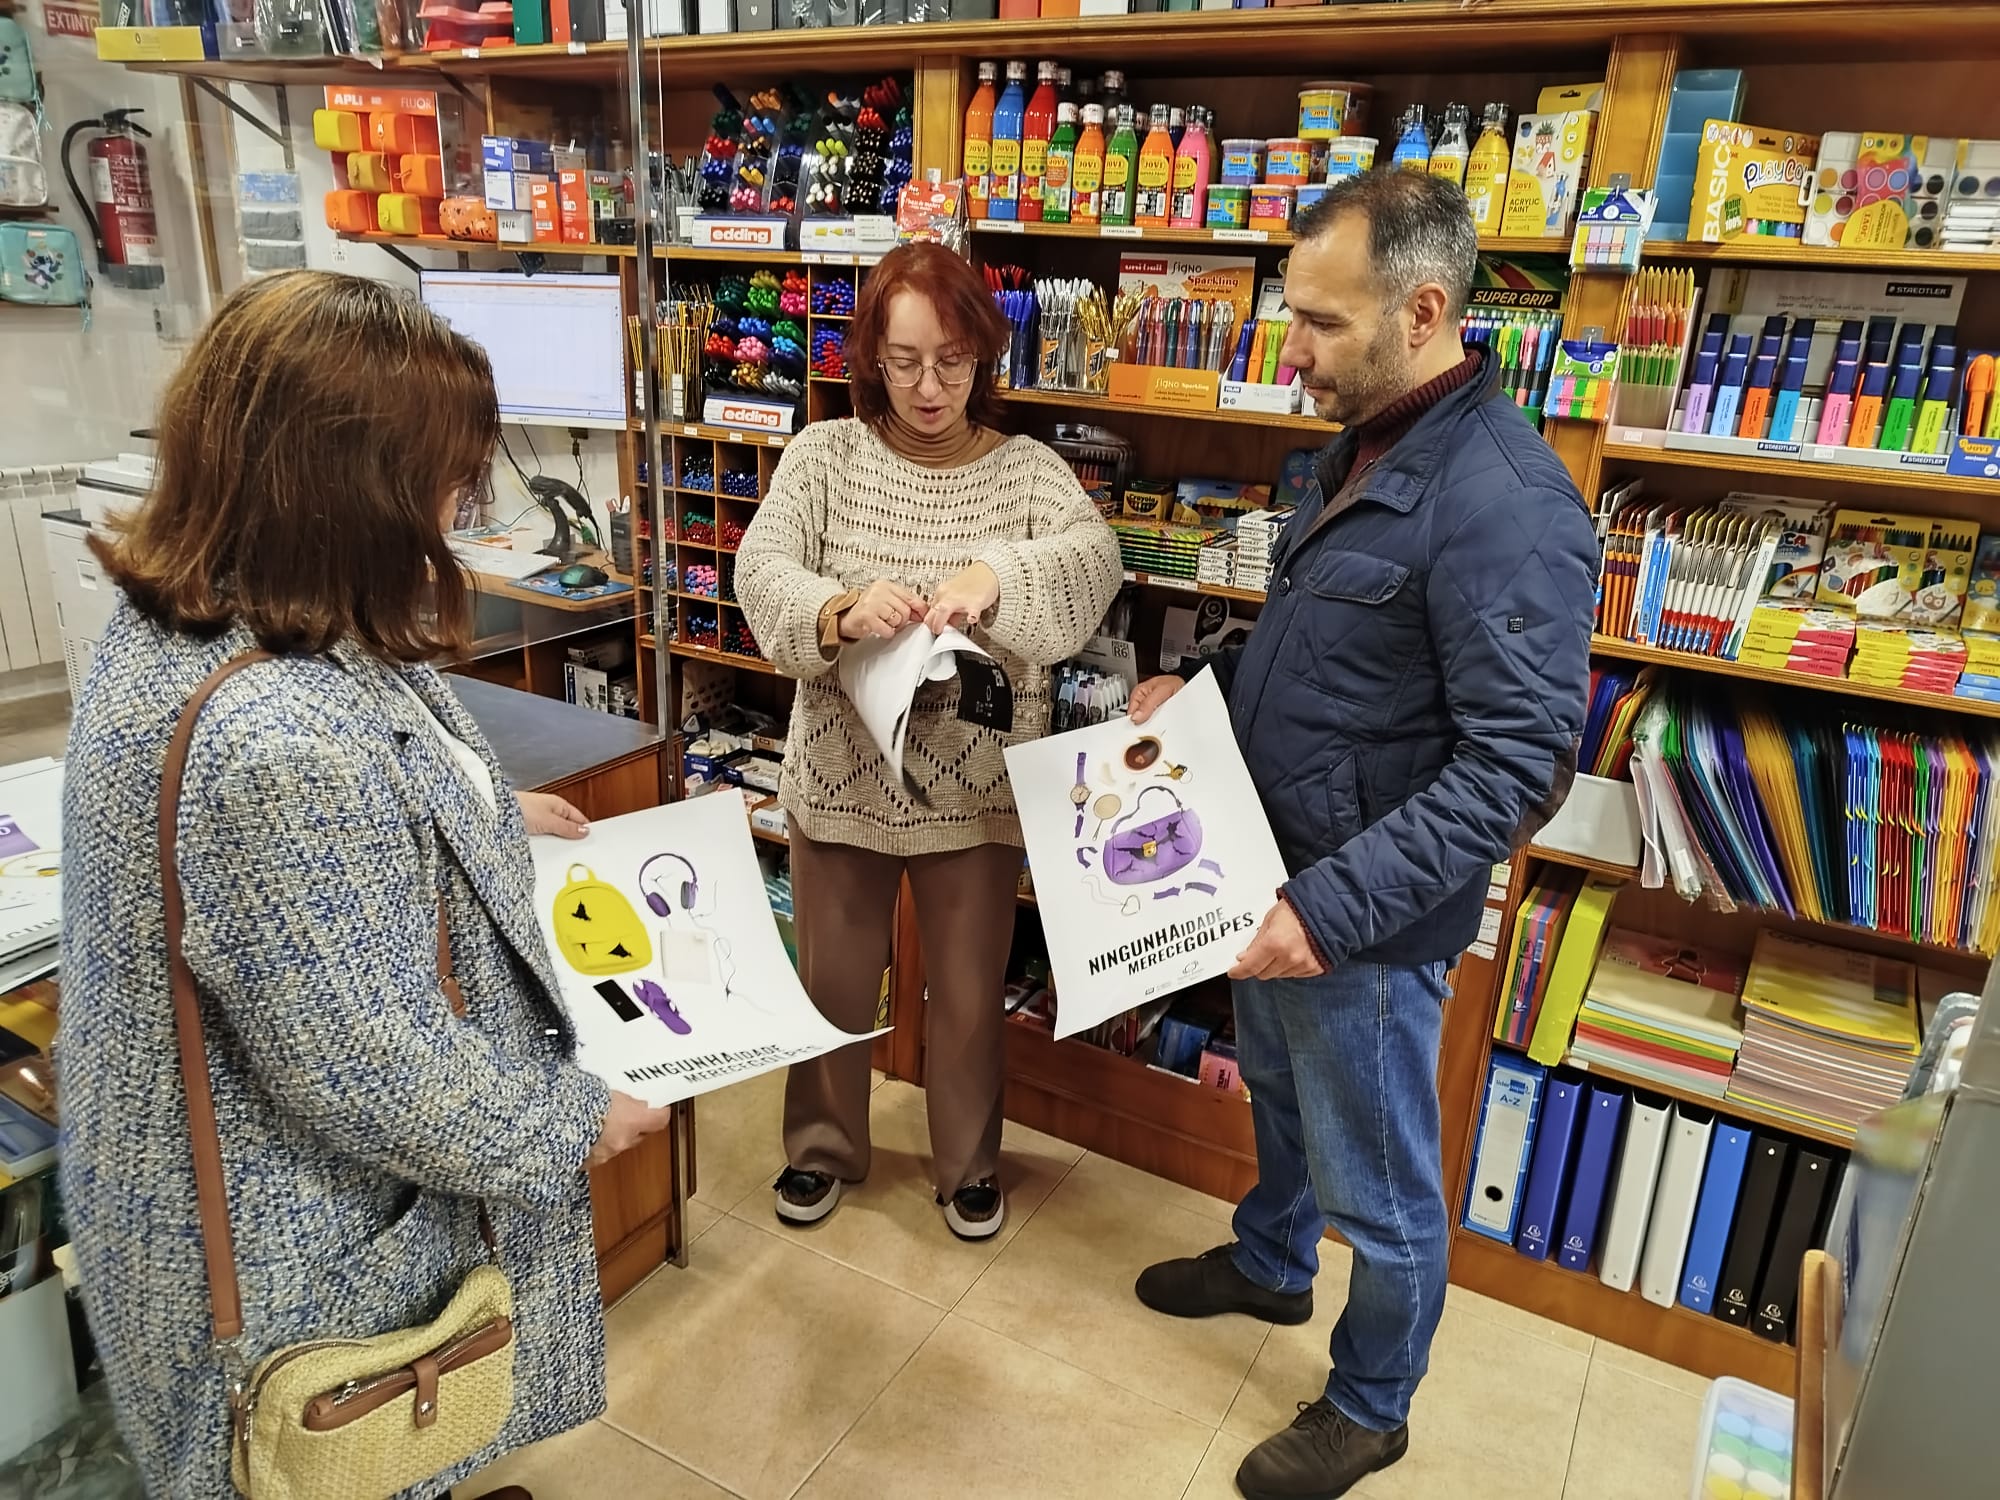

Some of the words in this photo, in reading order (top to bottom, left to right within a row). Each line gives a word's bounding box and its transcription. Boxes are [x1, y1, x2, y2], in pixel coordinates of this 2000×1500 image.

[46, 10, 101, 33] EXTINTO
[401, 96, 432, 109] FLUOR
[1079, 161, 1097, 169] JOVI
[1432, 161, 1454, 170] JOVI
[593, 175, 609, 184] APLI
[1515, 182, 1532, 190] JOVI
[1702, 144, 1731, 243] BASIC
[1509, 198, 1540, 206] ACRYLIC
[1724, 219, 1742, 230] 100%
[712, 228, 769, 243] edding
[1187, 275, 1239, 288] Sparkling
[1896, 285, 1947, 296] STAEDTLER
[1473, 290, 1517, 304] SUPER
[1519, 293, 1554, 306] GRIP
[724, 408, 778, 426] edding
[1764, 443, 1798, 452] STAEDTLER
[1907, 456, 1945, 464] STAEDTLER
[1129, 493, 1156, 503] Crayola
[1499, 1094, 1521, 1107] A-Z
